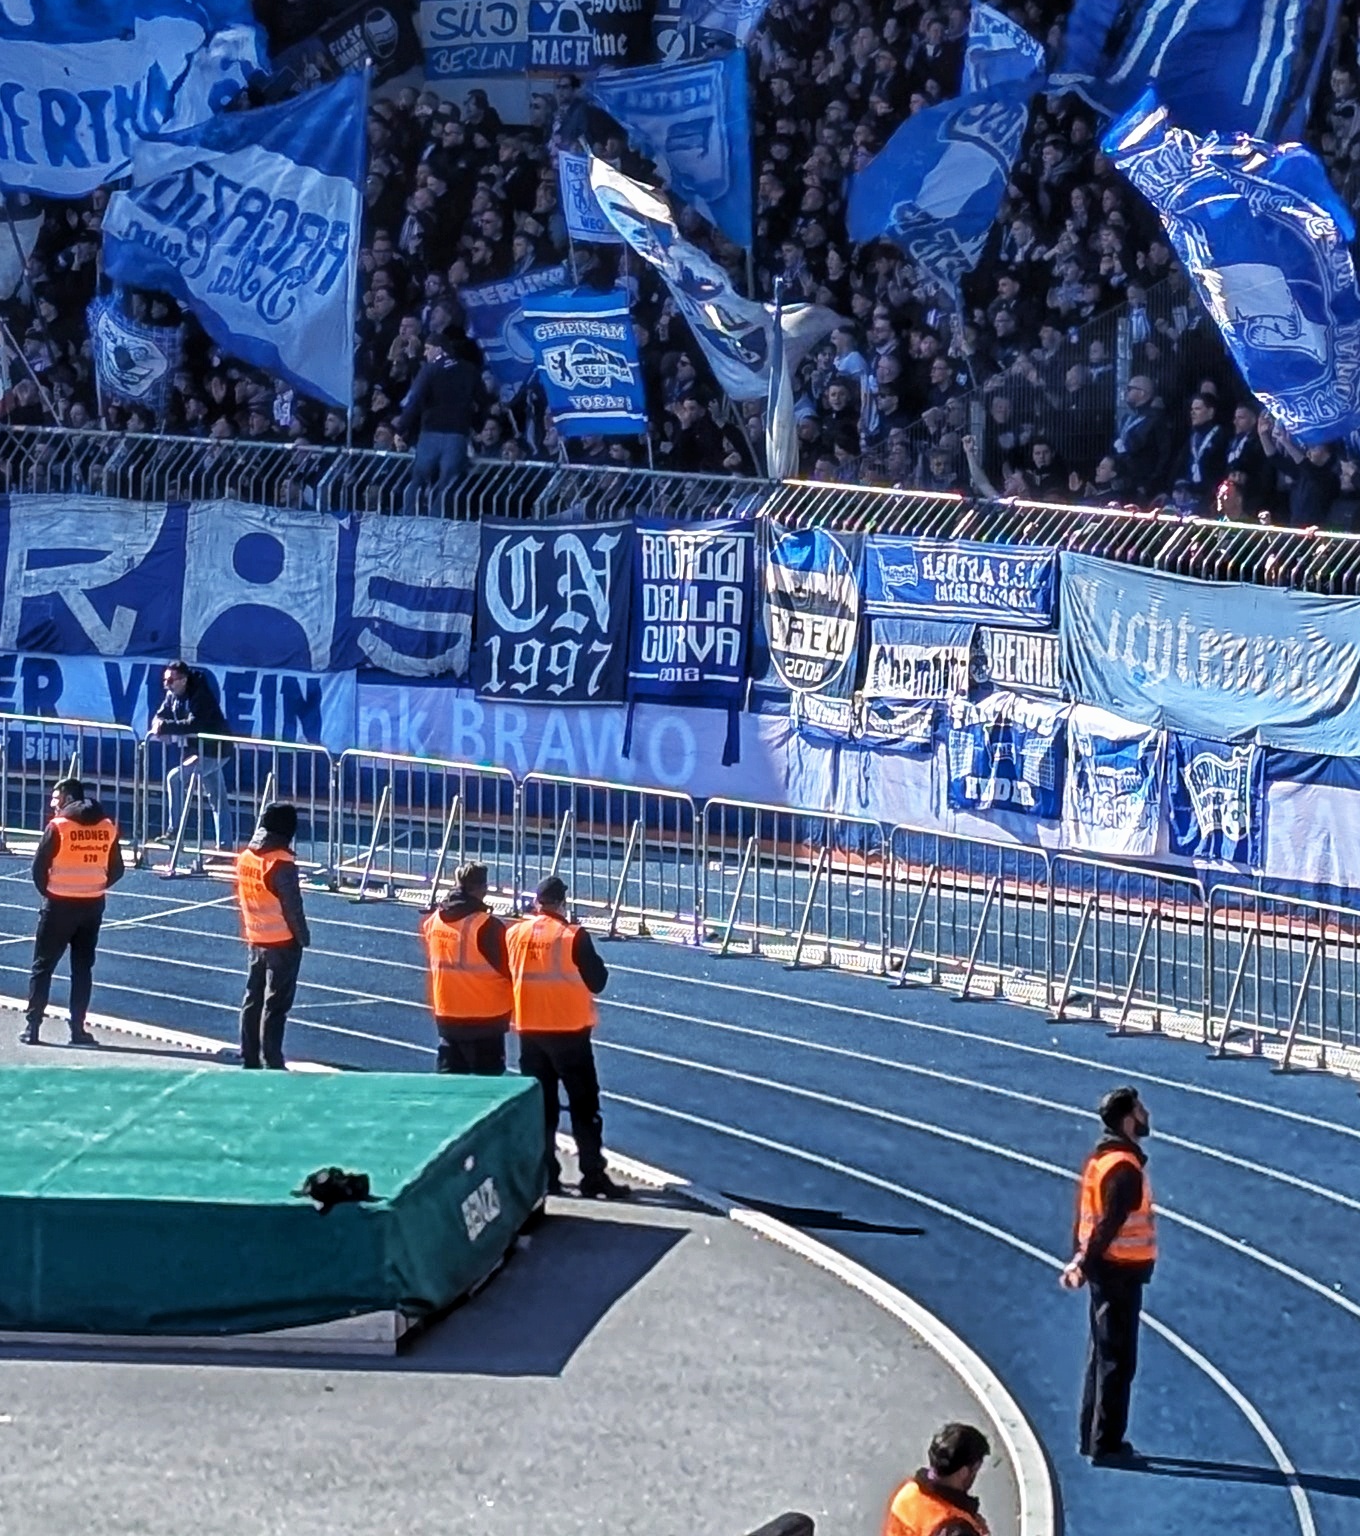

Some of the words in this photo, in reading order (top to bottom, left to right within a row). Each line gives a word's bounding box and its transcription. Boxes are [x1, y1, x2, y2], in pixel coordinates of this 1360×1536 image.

[533, 320, 627, 342] GEMEINSAM
[641, 534, 745, 582] RAGAZZI
[642, 584, 744, 625] DELLA
[481, 634, 614, 697] 1997
[641, 626, 741, 667] CURVA
[114, 658, 326, 748] VEIN
[452, 699, 697, 787] BRAWO
[69, 829, 110, 842] ORDNER
